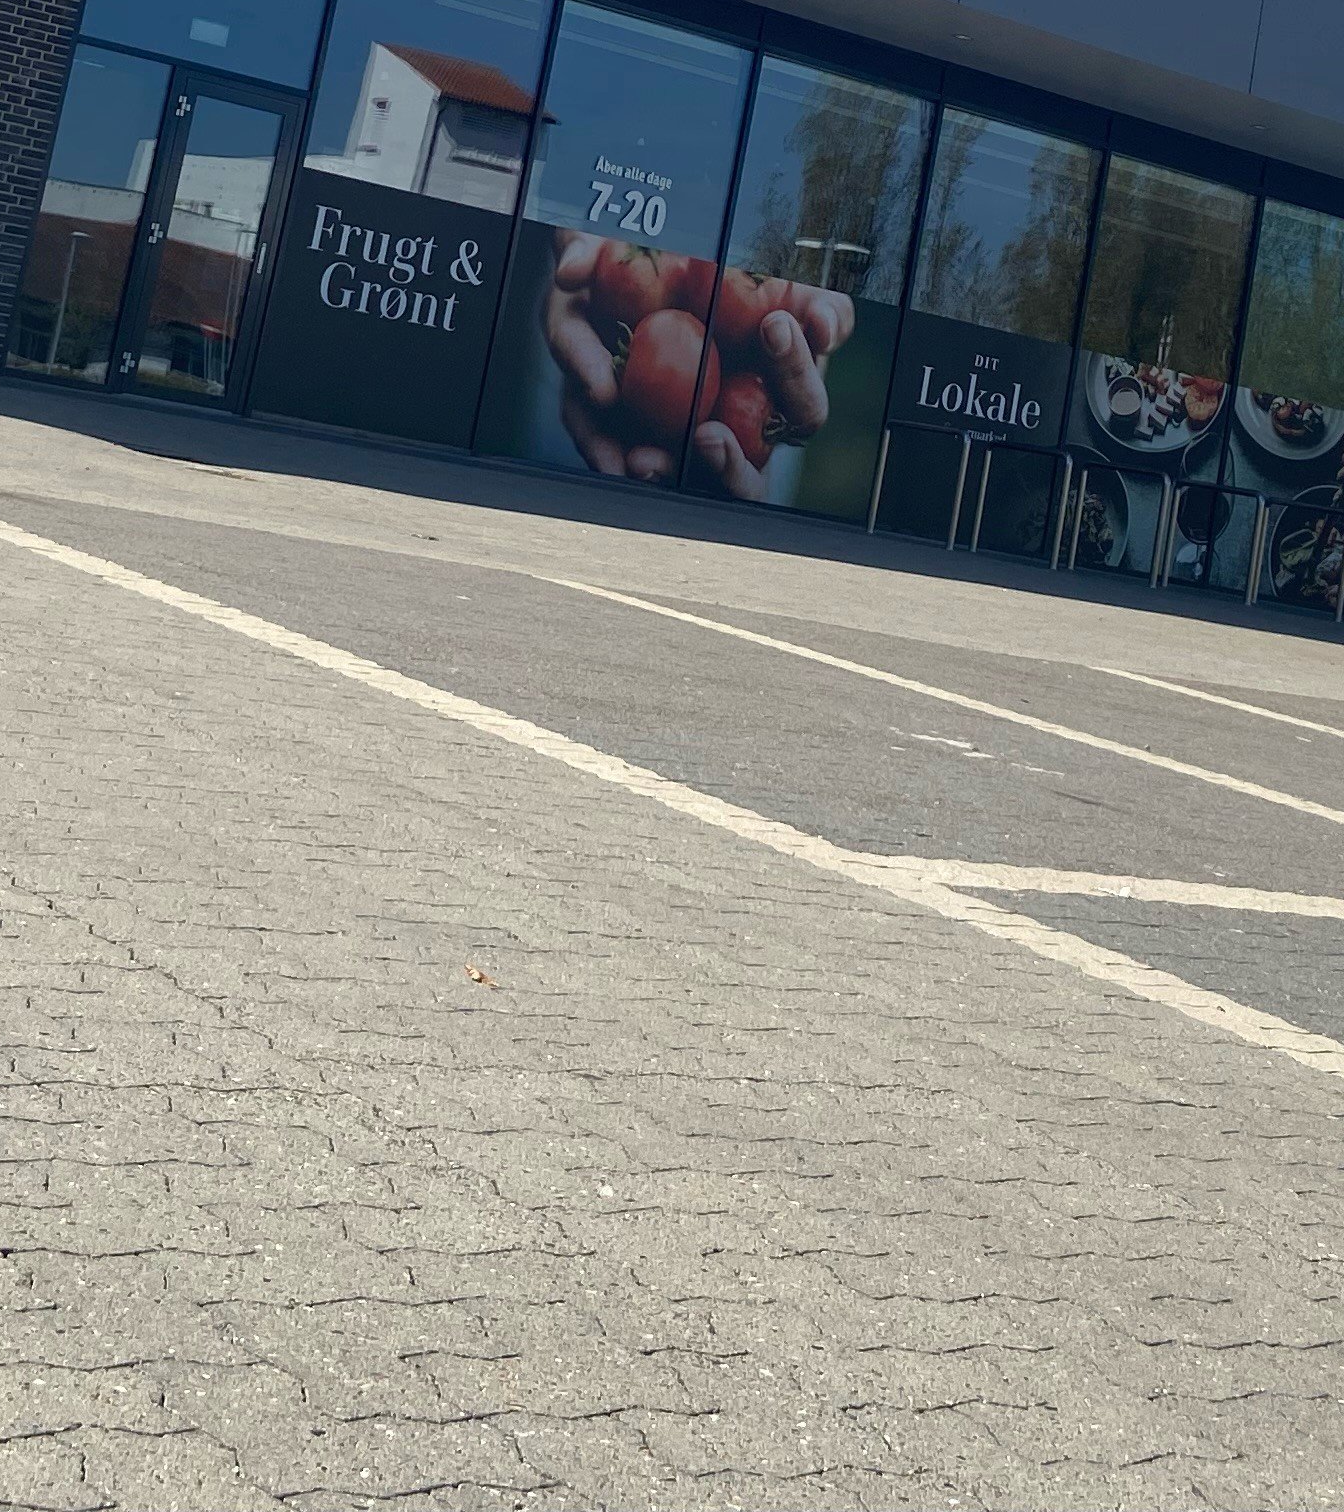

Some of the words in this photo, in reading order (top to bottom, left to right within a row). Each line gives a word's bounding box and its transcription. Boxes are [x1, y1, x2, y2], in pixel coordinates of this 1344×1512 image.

[588, 180, 667, 237] 7-20
[624, 167, 646, 183] alle
[646, 171, 673, 191] dage
[306, 204, 439, 284] Frugt
[449, 239, 484, 286] &
[320, 261, 460, 332] Grønt
[974, 354, 1000, 371] DIT
[916, 365, 1041, 429] Lokale
